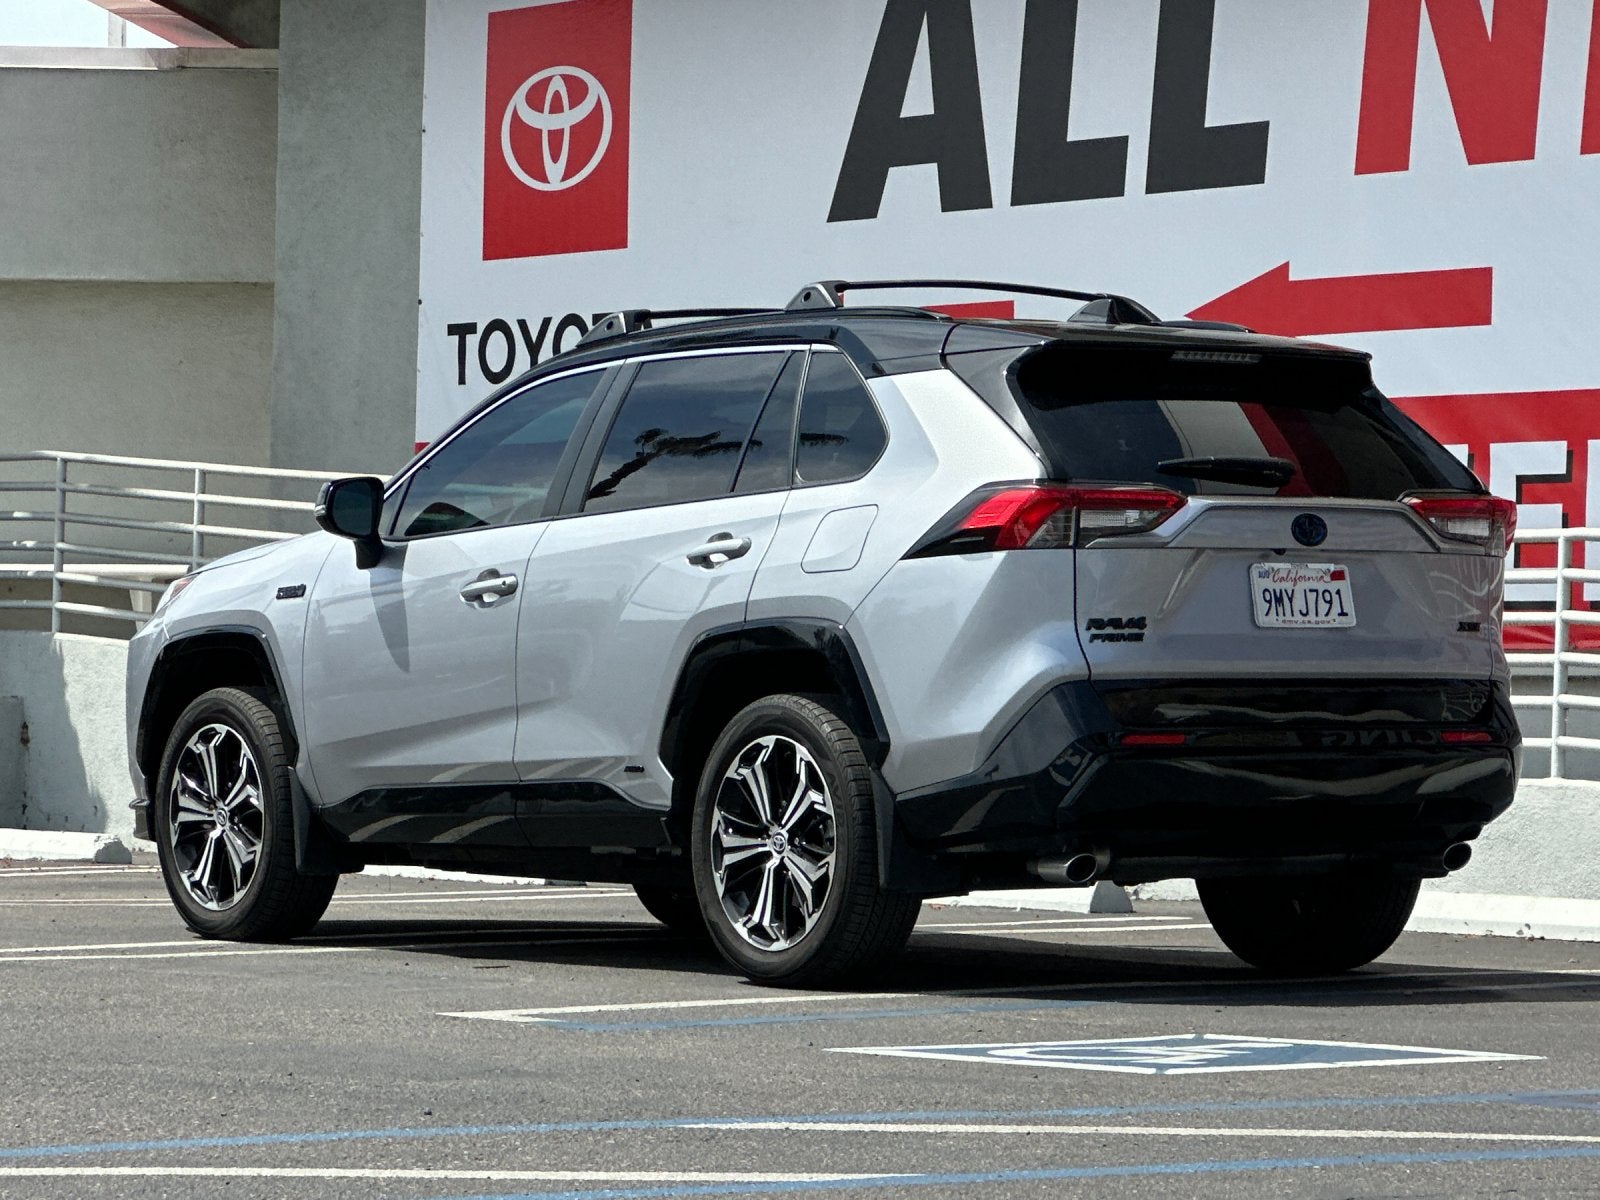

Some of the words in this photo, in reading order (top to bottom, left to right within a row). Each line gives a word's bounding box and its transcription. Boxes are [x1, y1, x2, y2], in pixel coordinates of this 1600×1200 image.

[826, 0, 1270, 223] ALL
[1354, 0, 1600, 176] N
[447, 312, 653, 386] TOYO
[1262, 588, 1348, 617] 9MYJ791
[1272, 569, 1331, 587] California
